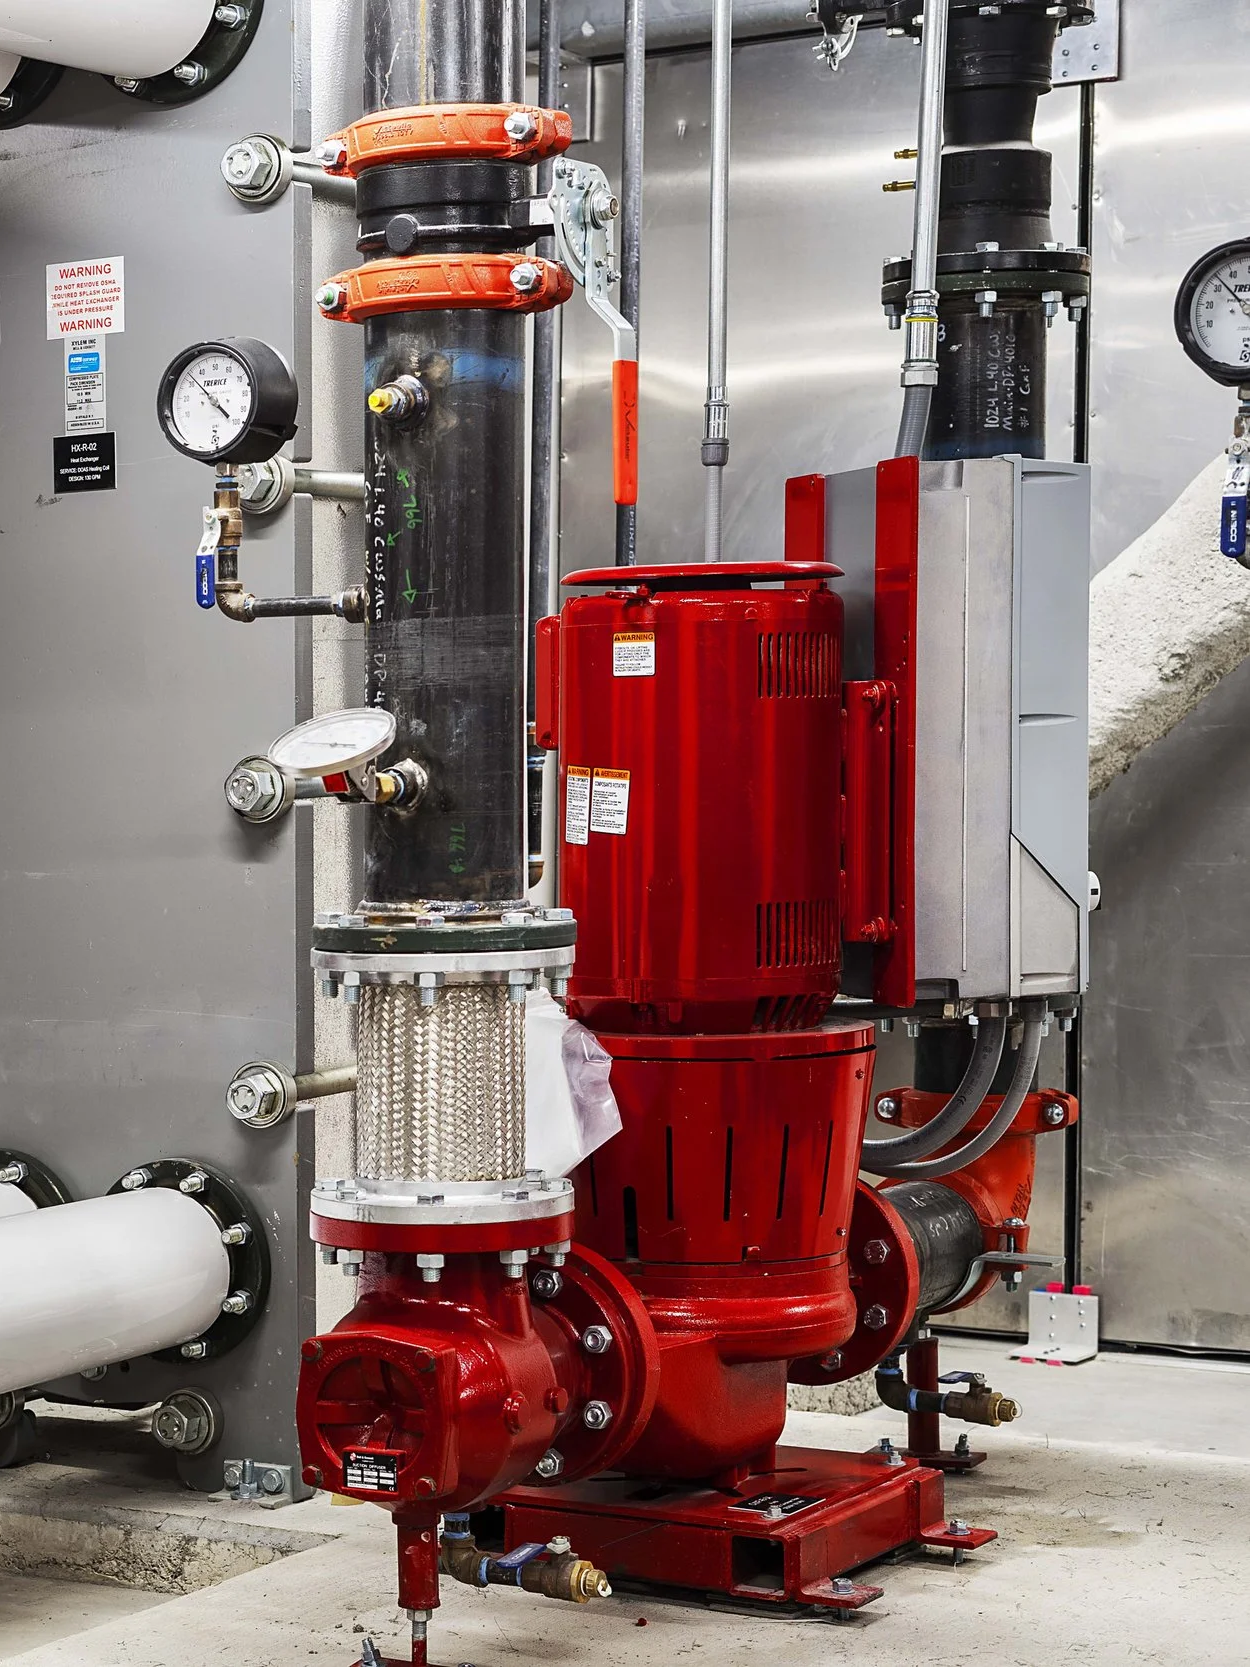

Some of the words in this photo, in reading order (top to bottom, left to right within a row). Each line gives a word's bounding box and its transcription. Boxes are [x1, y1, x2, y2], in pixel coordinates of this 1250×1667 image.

[59, 264, 111, 279] WARNING
[1229, 271, 1237, 279] 40
[86, 296, 120, 304] EXCHANGER
[1206, 301, 1213, 309] 20
[60, 317, 112, 332] WARNING
[204, 378, 228, 387] TRERICE
[984, 398, 1000, 428] 1024
[71, 443, 97, 452] HX-R-02
